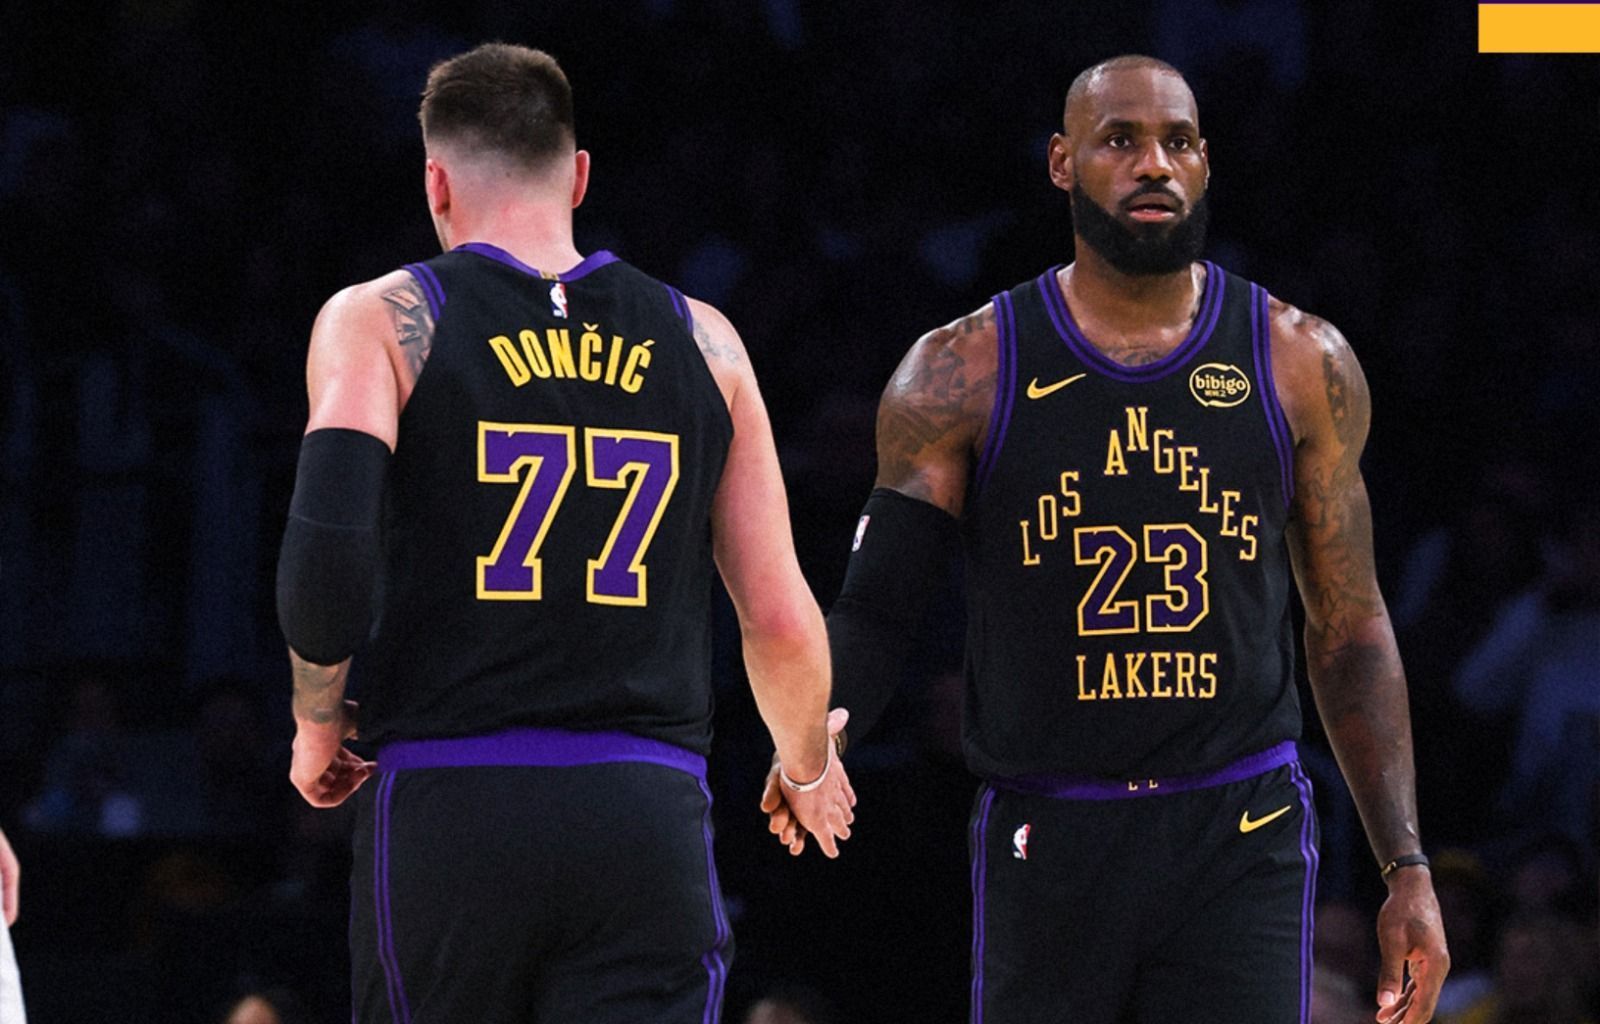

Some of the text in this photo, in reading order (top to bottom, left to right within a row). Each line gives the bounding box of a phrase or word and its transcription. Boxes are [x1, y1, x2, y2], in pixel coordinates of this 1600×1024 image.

[489, 323, 656, 393] DONČIĆ
[1195, 374, 1247, 395] bibigo
[476, 421, 680, 607] 77
[1020, 407, 1259, 566] LOS ANGELES
[1074, 524, 1210, 637] 23
[1076, 652, 1218, 700] LAKERS
